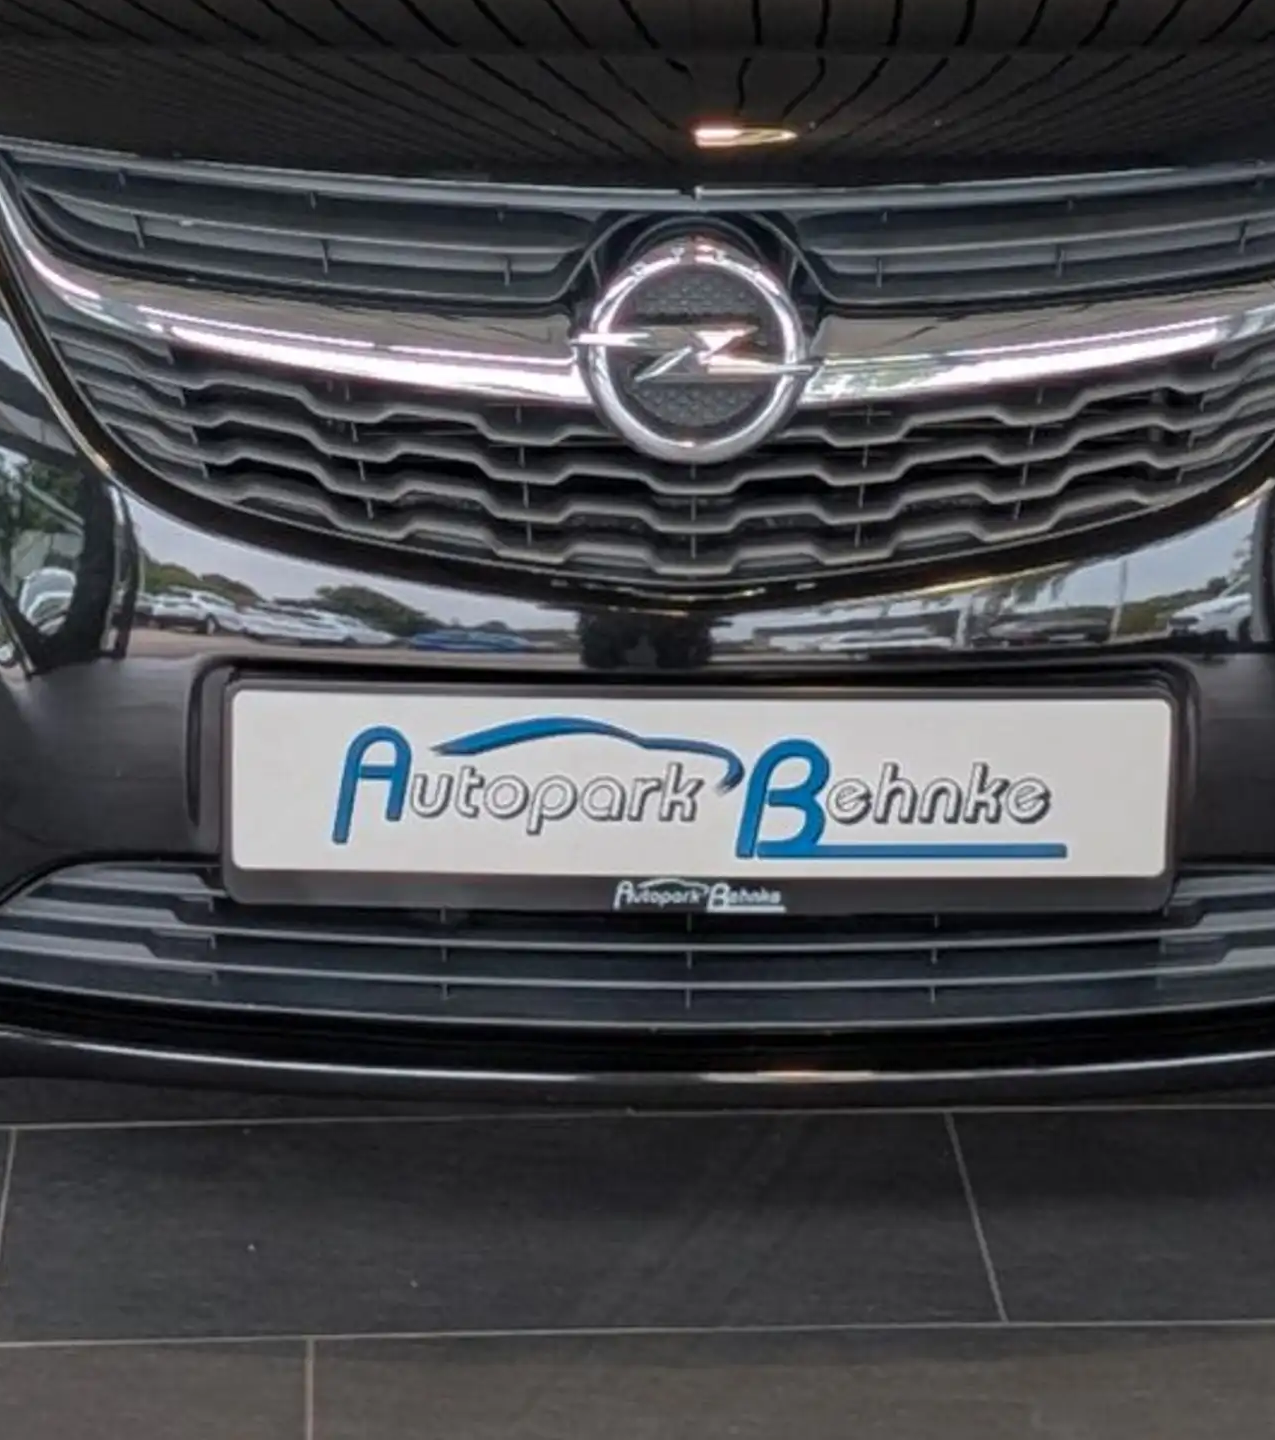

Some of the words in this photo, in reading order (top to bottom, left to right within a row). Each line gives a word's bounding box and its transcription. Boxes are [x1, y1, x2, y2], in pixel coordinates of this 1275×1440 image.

[332, 724, 704, 844] Autopark
[736, 738, 1052, 860] Behnke
[613, 880, 701, 910] Autopark
